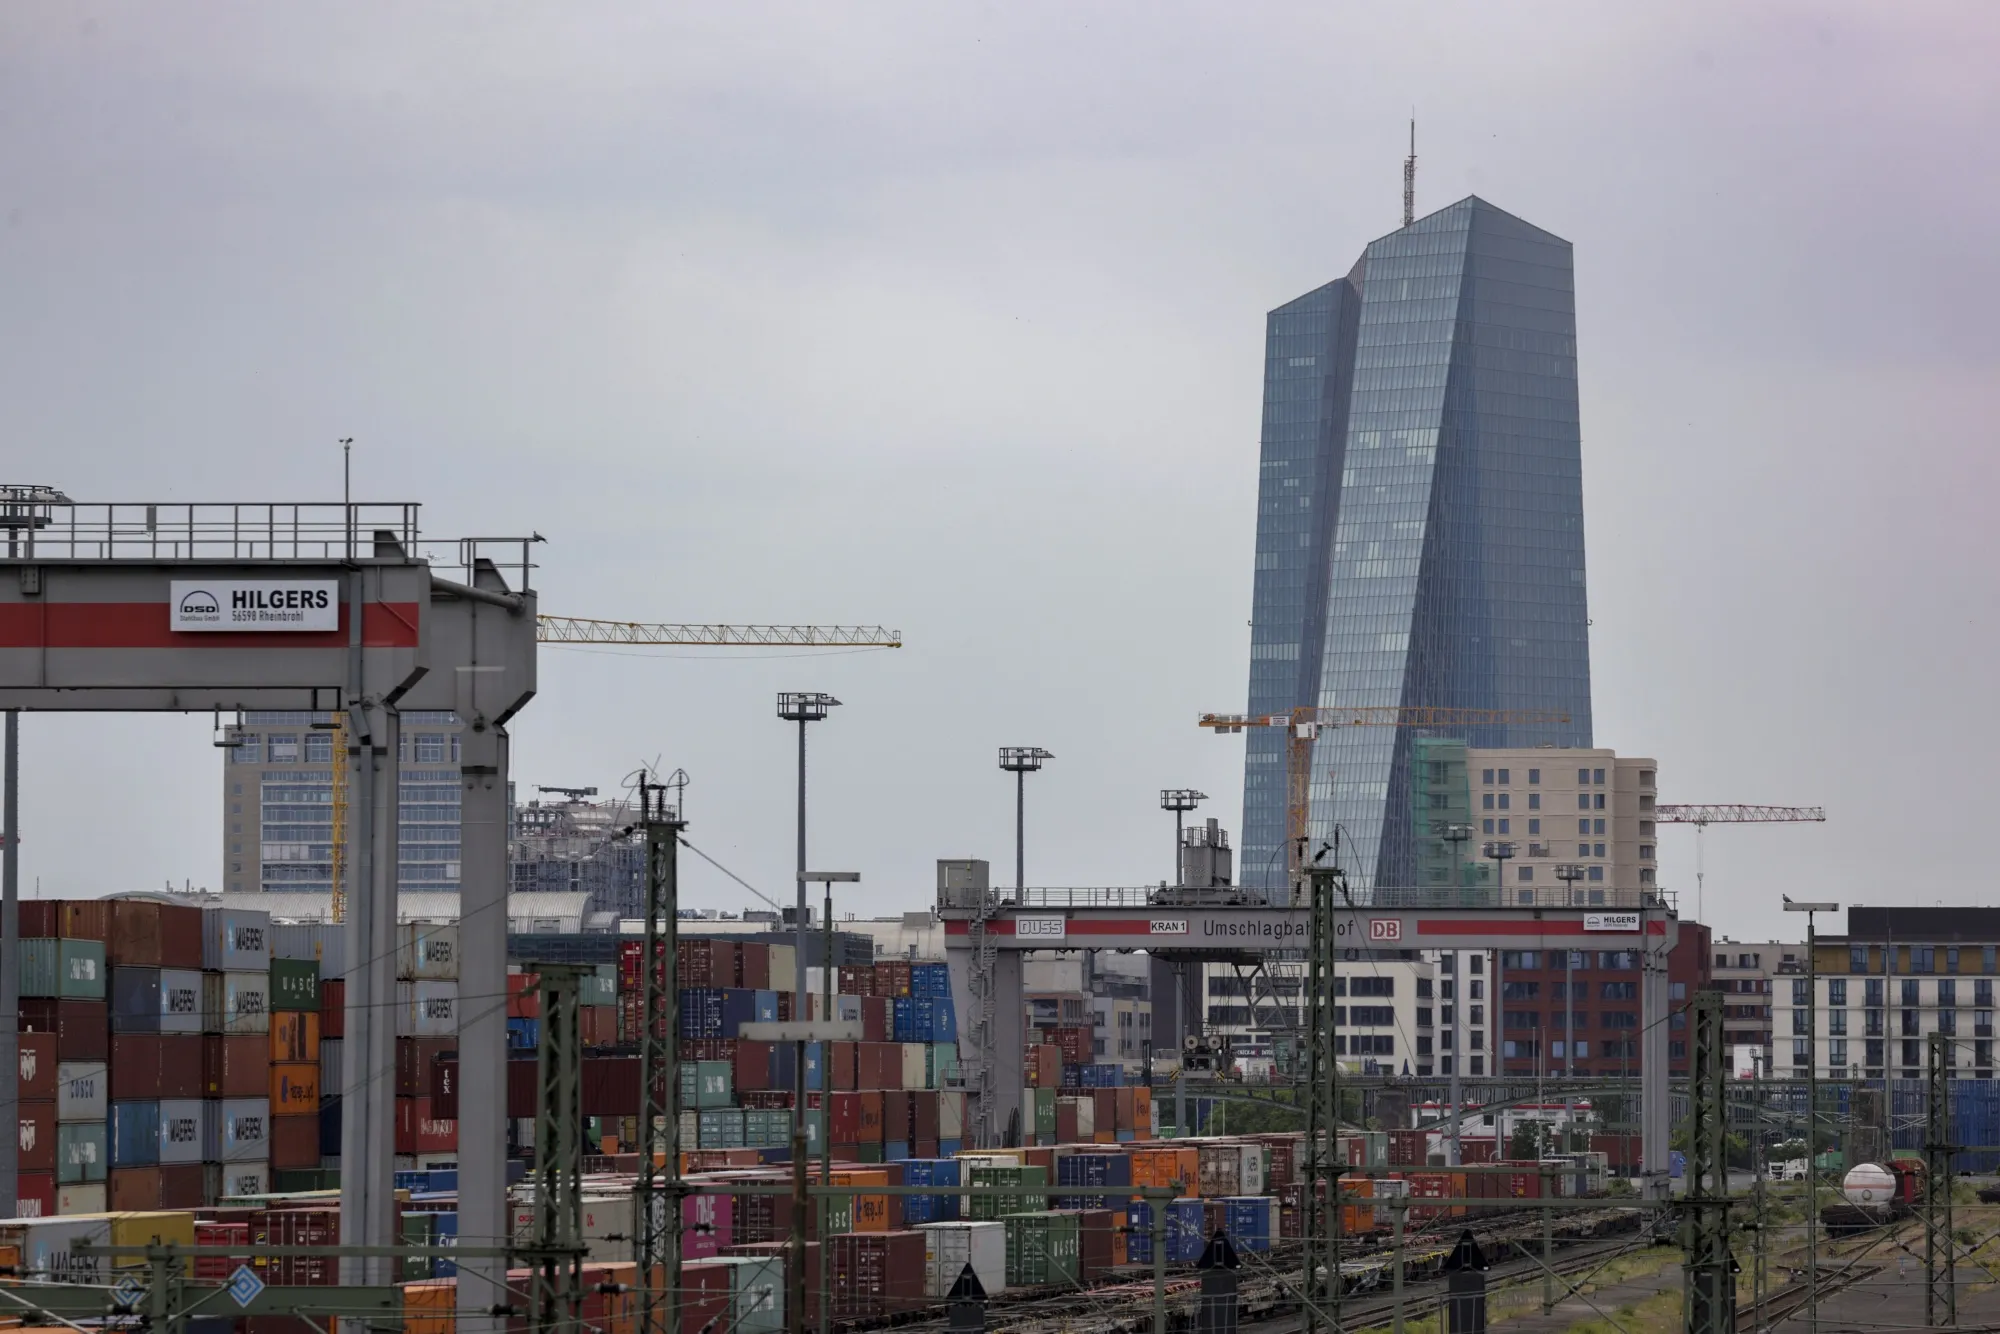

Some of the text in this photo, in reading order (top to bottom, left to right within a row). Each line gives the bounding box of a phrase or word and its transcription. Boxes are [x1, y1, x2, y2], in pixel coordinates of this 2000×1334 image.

[232, 590, 328, 609] HILGERS
[232, 610, 304, 622] 56598 Rheinbrohl
[1019, 920, 1062, 934] DUSS
[1151, 922, 1185, 931] KRAN 1
[1204, 920, 1353, 940] Umschlagbahof
[1373, 922, 1398, 938] DB
[235, 927, 264, 951] MAERSK
[426, 941, 452, 961] MAERSK
[169, 988, 197, 1012] MAERSK
[235, 991, 264, 1014] MAERSK
[426, 998, 453, 1019] MAERSK
[71, 1080, 94, 1099] COSCO
[169, 1119, 197, 1142] MAERSK
[235, 1117, 263, 1141] MAERSK
[236, 1175, 260, 1196] MAERSK
